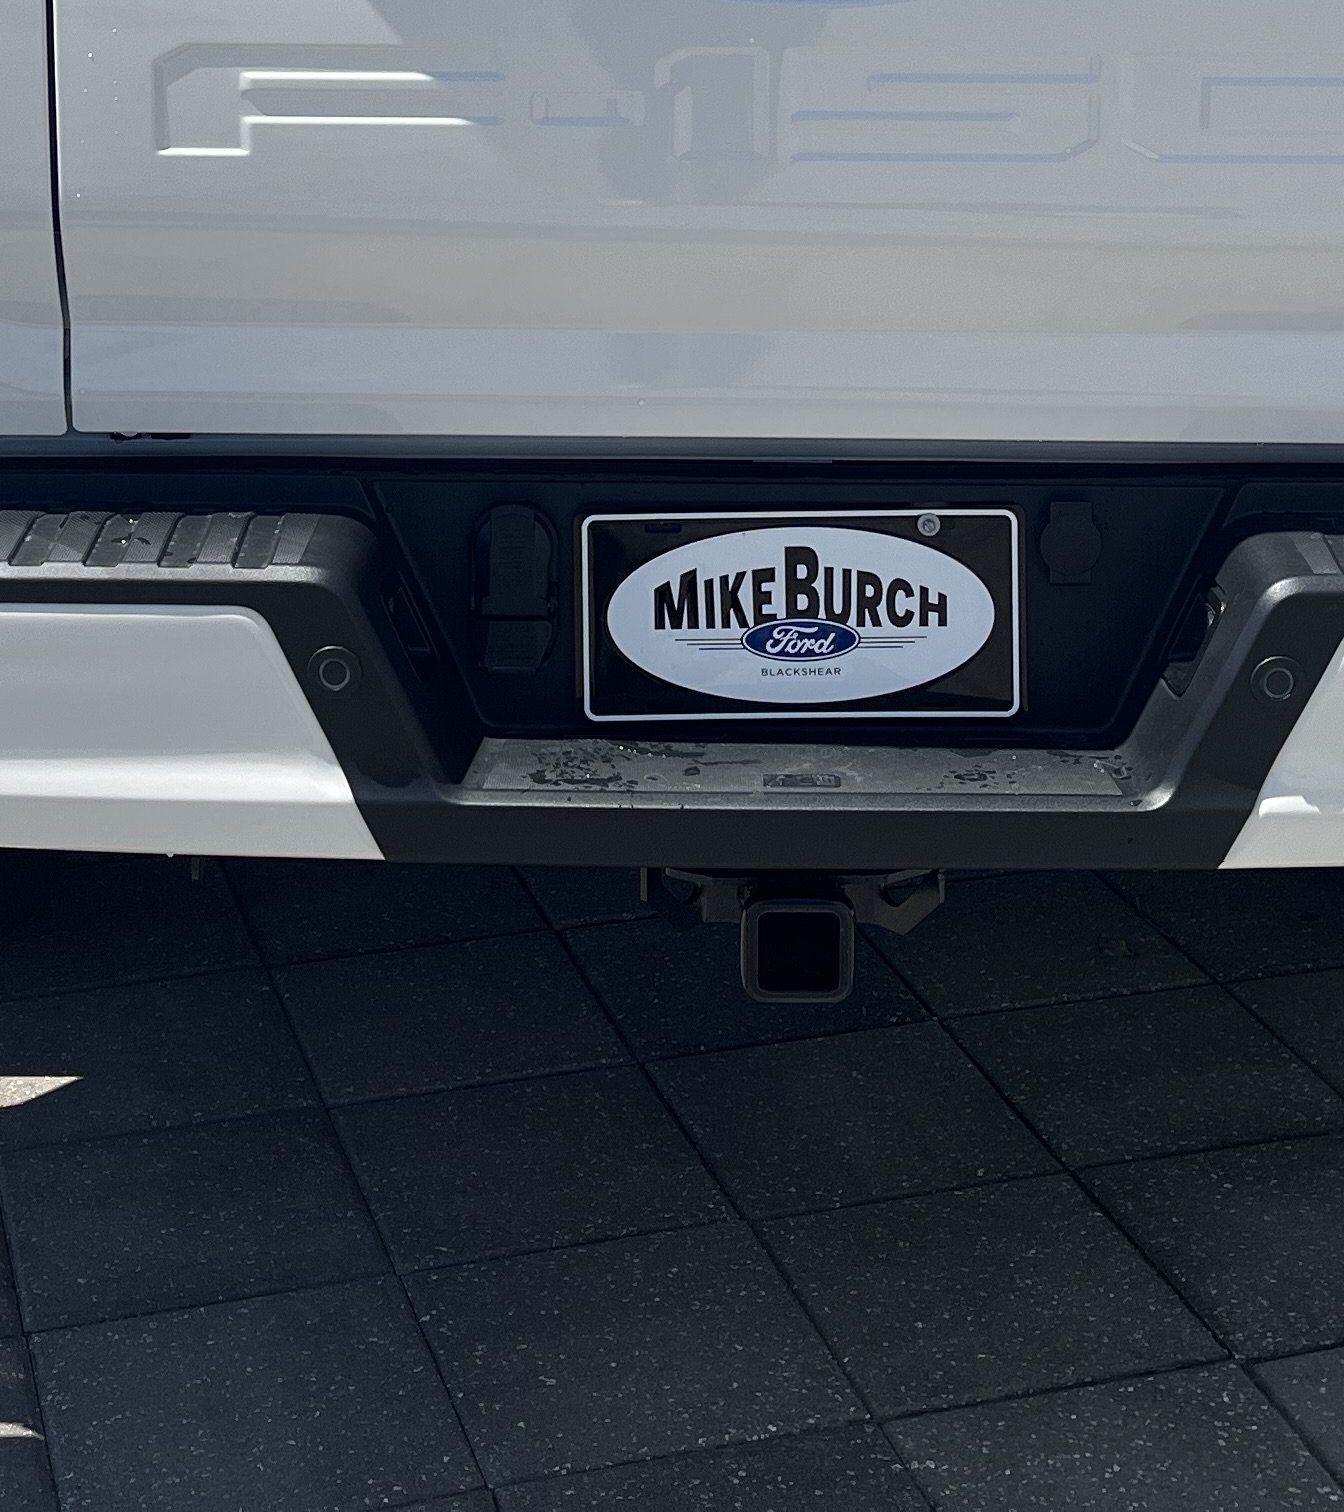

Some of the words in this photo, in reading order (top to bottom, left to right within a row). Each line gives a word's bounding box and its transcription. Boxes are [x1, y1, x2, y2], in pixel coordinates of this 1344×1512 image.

[653, 567, 777, 631] MIKE
[783, 546, 948, 628] BURCH
[765, 625, 836, 655] Ford
[760, 666, 842, 677] BLACKSHEAR
